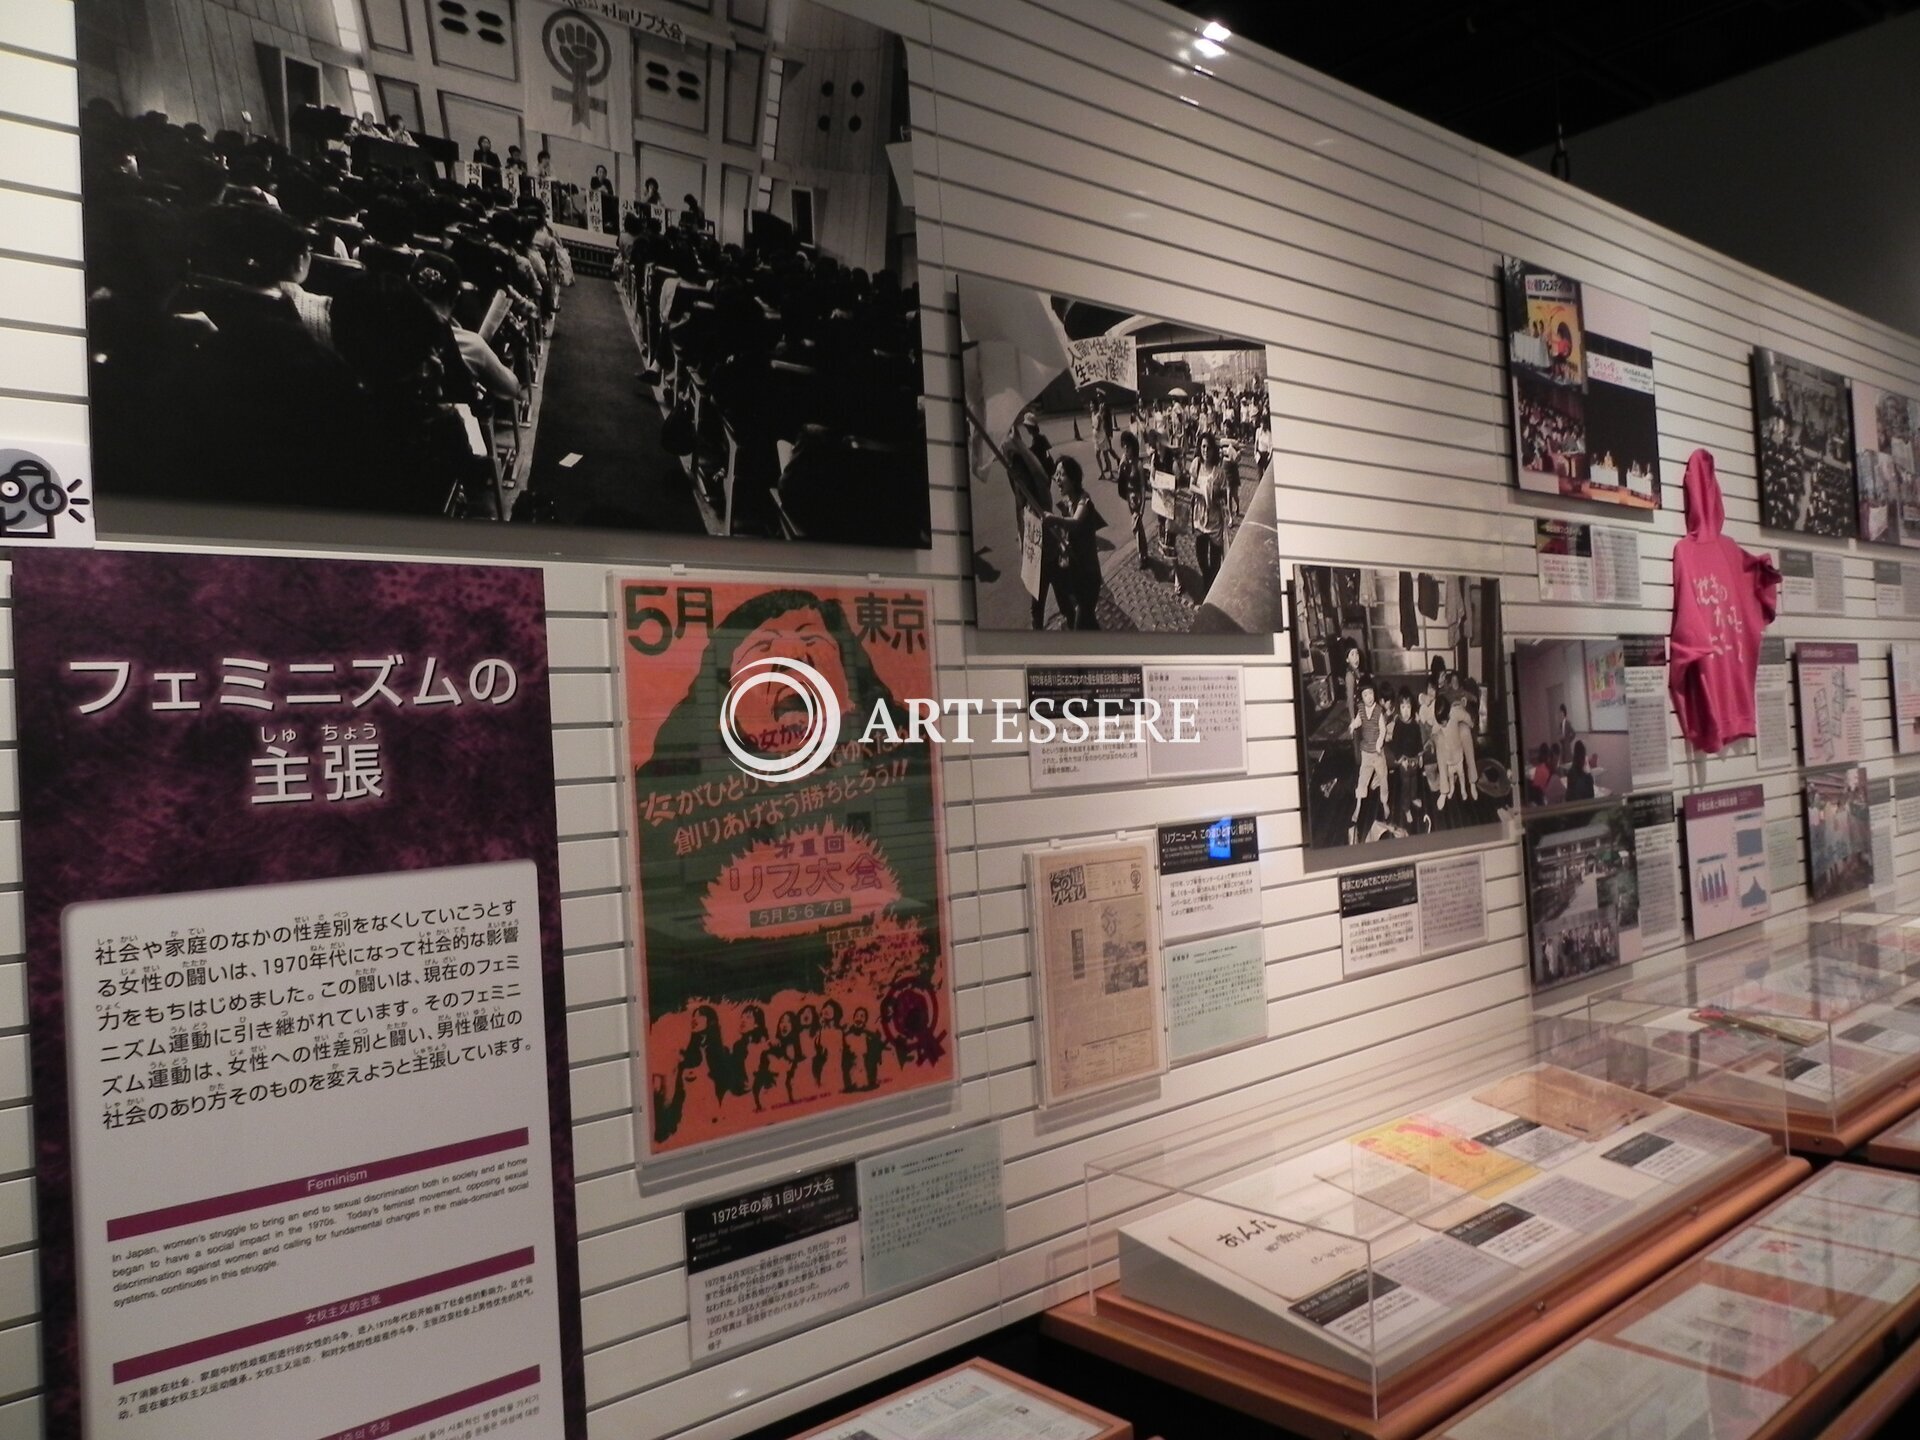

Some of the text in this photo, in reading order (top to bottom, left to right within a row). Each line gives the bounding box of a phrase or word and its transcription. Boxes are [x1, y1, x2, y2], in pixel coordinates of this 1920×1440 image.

[625, 586, 926, 656] 5月 東京
[69, 654, 518, 714] フェミニズムの
[260, 722, 378, 743] しゅ ちょう
[250, 743, 385, 804] 主張
[730, 853, 885, 903] リブ大会
[95, 900, 517, 966] 社会や家庭のなかの性差別をなくしていこうとす
[98, 926, 518, 998] る女性の闘いは、1970年代になって社会的な影響
[98, 955, 520, 1032] 力をもちはじめました。この闘いは、現在のフェミ
[101, 983, 521, 1062] ニズム運動に引き継がれています。そのフェミニ
[102, 1010, 523, 1097] ズム運動は、女性への性差別と闘い、男性優位の
[103, 1036, 533, 1130] 社会のあり方そのものを変えようと主張しています。
[163, 1235, 206, 1251] women's
[209, 1225, 246, 1241] struggle
[250, 1222, 259, 1230] to
[262, 1216, 285, 1228] bring
[334, 1197, 361, 1211] sexual
[364, 1184, 419, 1203] discrimination
[422, 1179, 439, 1189] both
[452, 1170, 478, 1182] society
[481, 1165, 495, 1174] and
[507, 1158, 528, 1168] home
[307, 1169, 368, 1191] Feminism
[711, 1176, 835, 1225] 1972年の第1回リブ大会
[112, 1264, 144, 1278] began
[150, 1259, 160, 1269] to
[165, 1253, 190, 1265] have
[207, 1242, 235, 1255] social
[239, 1234, 270, 1247] impact
[383, 1199, 415, 1211] feminist
[466, 1176, 500, 1192] opposing
[113, 1270, 182, 1293] discrimination
[186, 1259, 220, 1275] against
[225, 1252, 258, 1265] women
[262, 1244, 280, 1256] and
[331, 1219, 383, 1238] fundamental
[386, 1210, 420, 1224] changes
[161, 1278, 208, 1296] continues
[221, 1269, 238, 1281] this
[304, 1293, 382, 1325] 女权主义的主张
